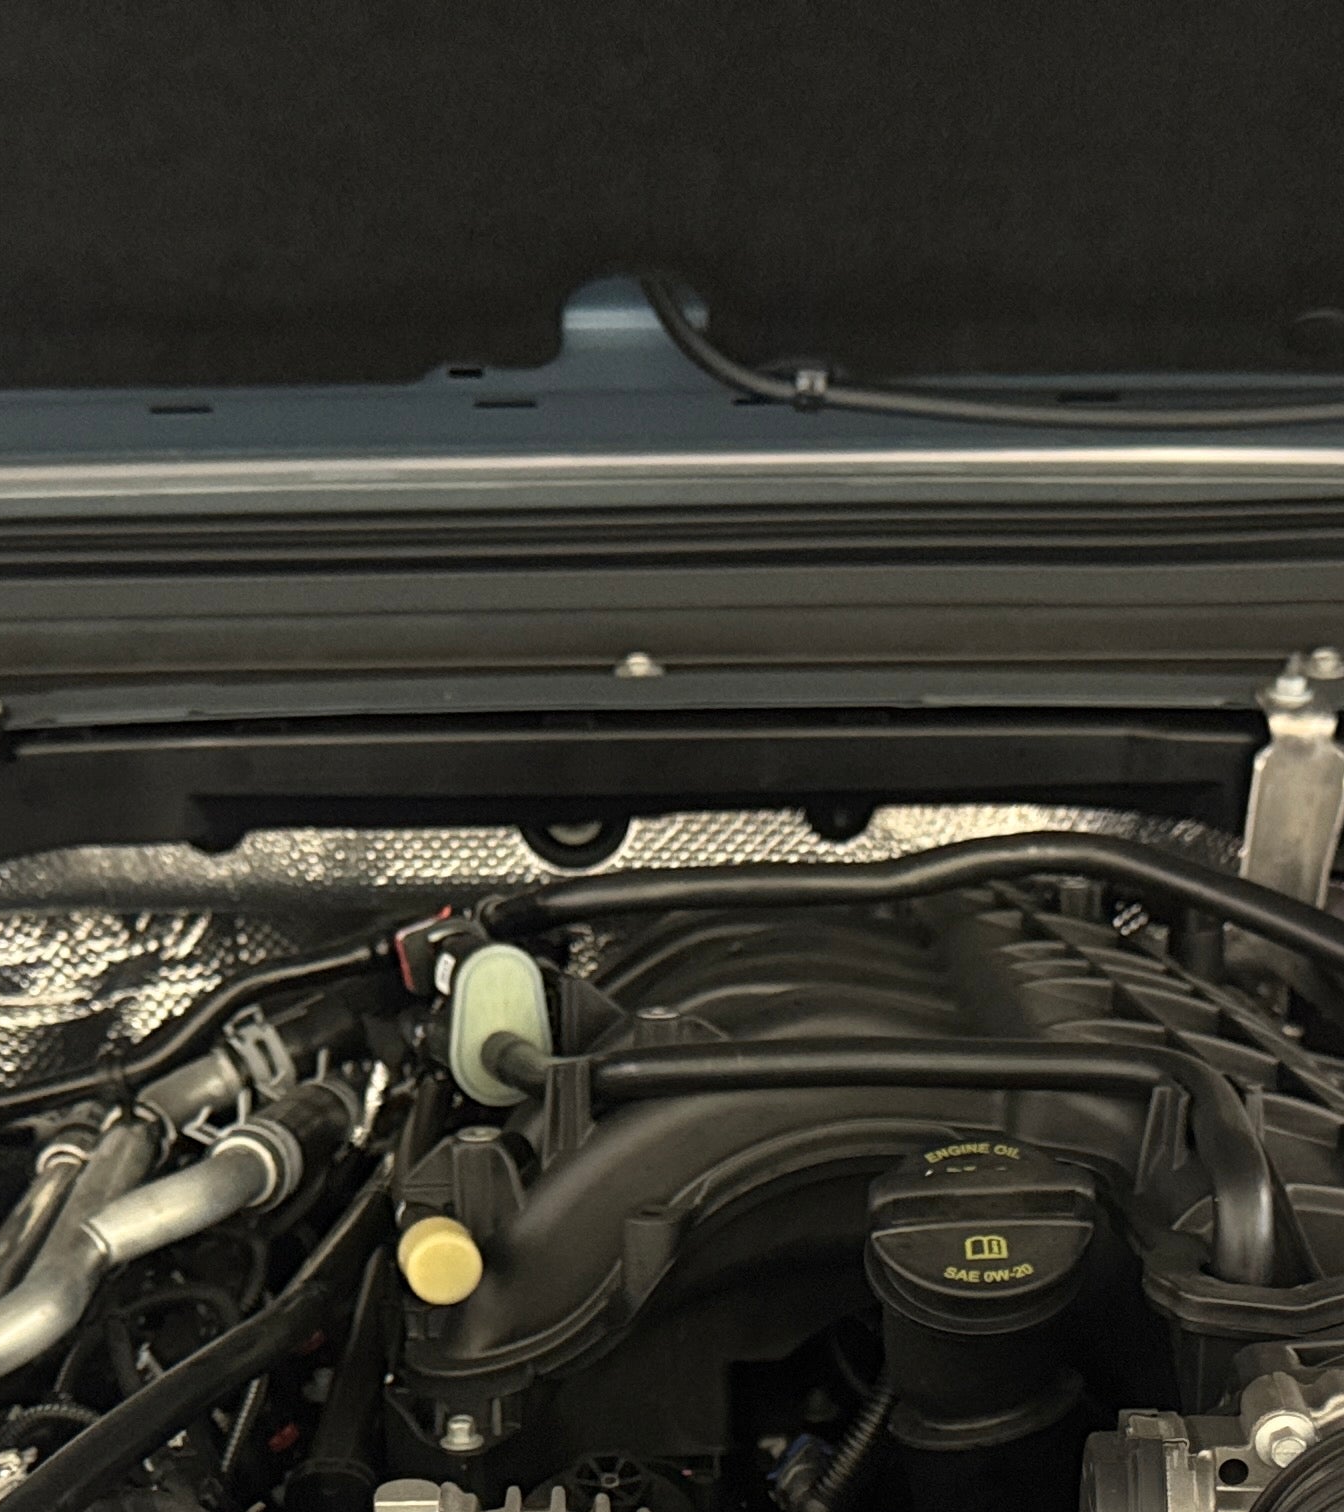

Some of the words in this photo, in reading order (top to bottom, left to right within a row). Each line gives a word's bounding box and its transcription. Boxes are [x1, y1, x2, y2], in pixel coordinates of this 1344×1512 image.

[924, 1142, 990, 1164] ENGINE
[993, 1144, 1022, 1160] OIL
[943, 1266, 981, 1283] SAE
[984, 1263, 1035, 1283] 0W-20
